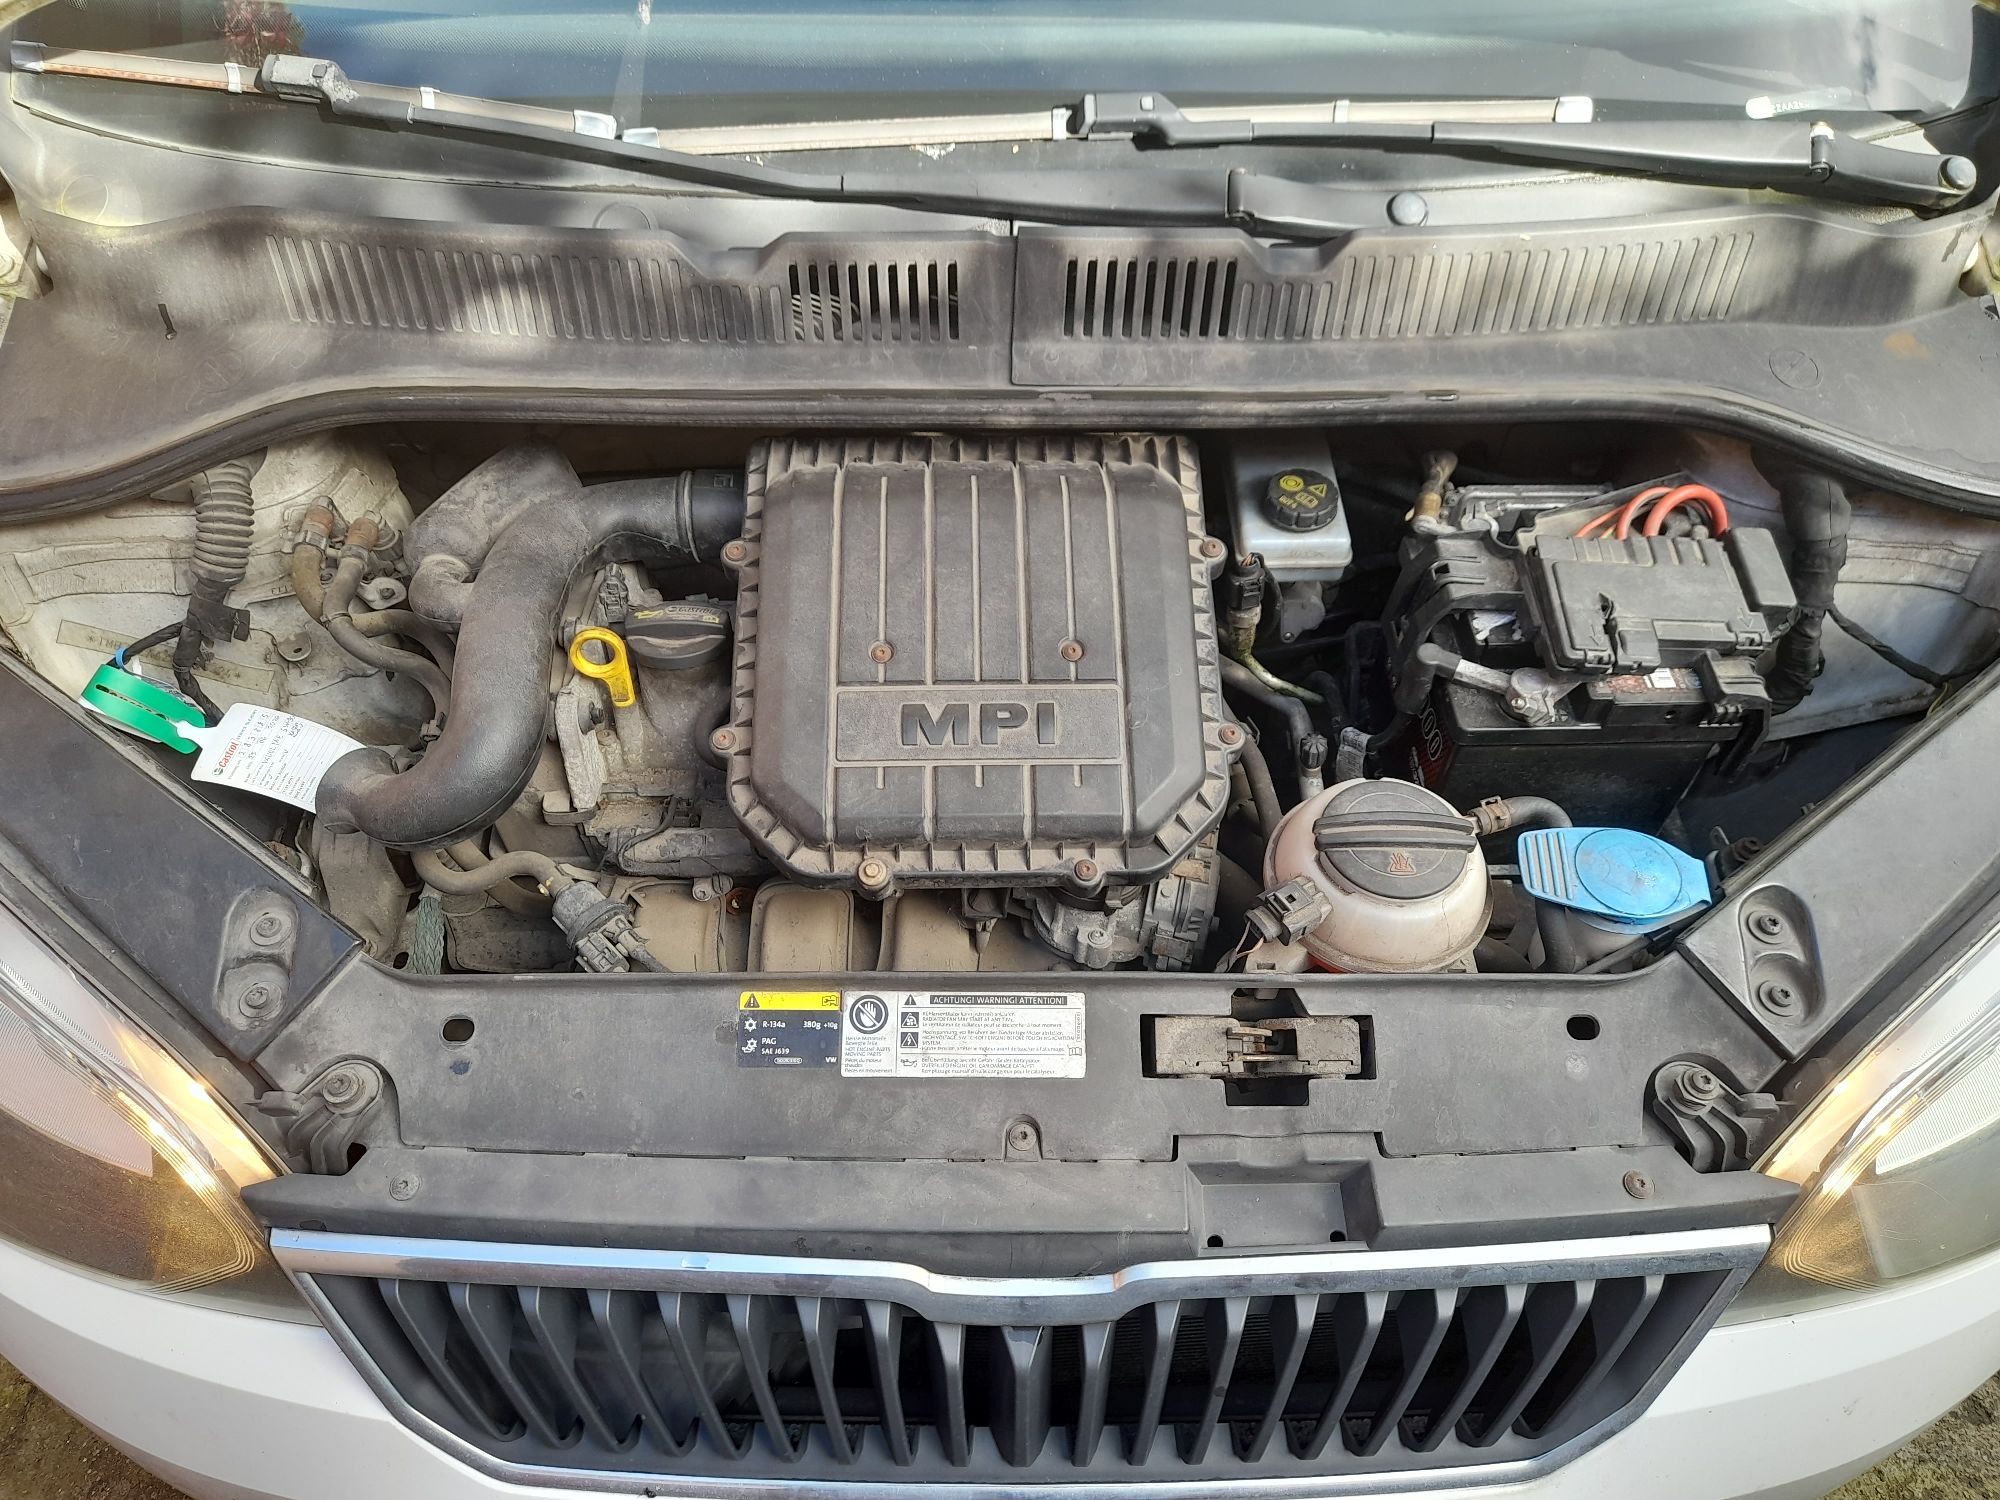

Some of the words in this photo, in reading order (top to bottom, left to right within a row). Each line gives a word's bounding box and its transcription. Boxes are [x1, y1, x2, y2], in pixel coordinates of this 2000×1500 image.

[902, 702, 1056, 746] MPI
[218, 741, 239, 768] Castrol
[933, 996, 975, 1004] ACHTUNG!
[977, 996, 1018, 1004] WARNING!
[1019, 996, 1065, 1005] ATTENTION!
[803, 1021, 821, 1030] 380g
[761, 1037, 777, 1045] PAG
